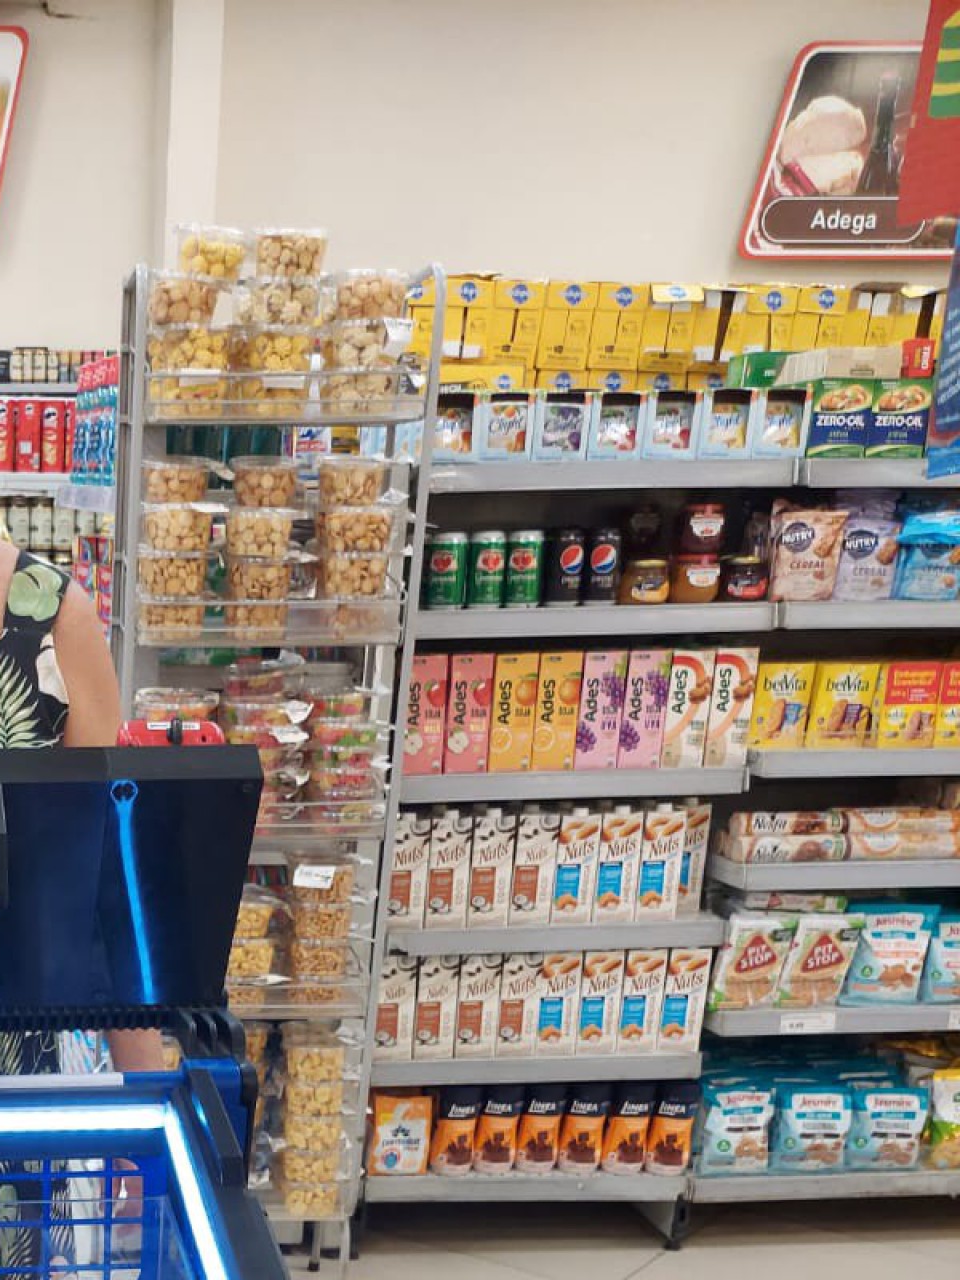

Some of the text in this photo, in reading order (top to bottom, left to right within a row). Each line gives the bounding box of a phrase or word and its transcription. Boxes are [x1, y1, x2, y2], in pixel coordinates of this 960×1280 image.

[810, 209, 877, 235] Adega
[408, 680, 421, 726] AdeS
[454, 680, 468, 725] AdeS
[497, 680, 512, 724] AdeS
[541, 679, 556, 723] AdeS
[584, 678, 600, 722] AdeS
[629, 677, 644, 721] AdeS
[671, 669, 688, 714] AdeS
[716, 668, 731, 712] AdeS
[479, 842, 508, 864] Nuts
[564, 840, 594, 862] Nuts
[606, 838, 637, 861] Nuts
[650, 836, 679, 859] Nuts
